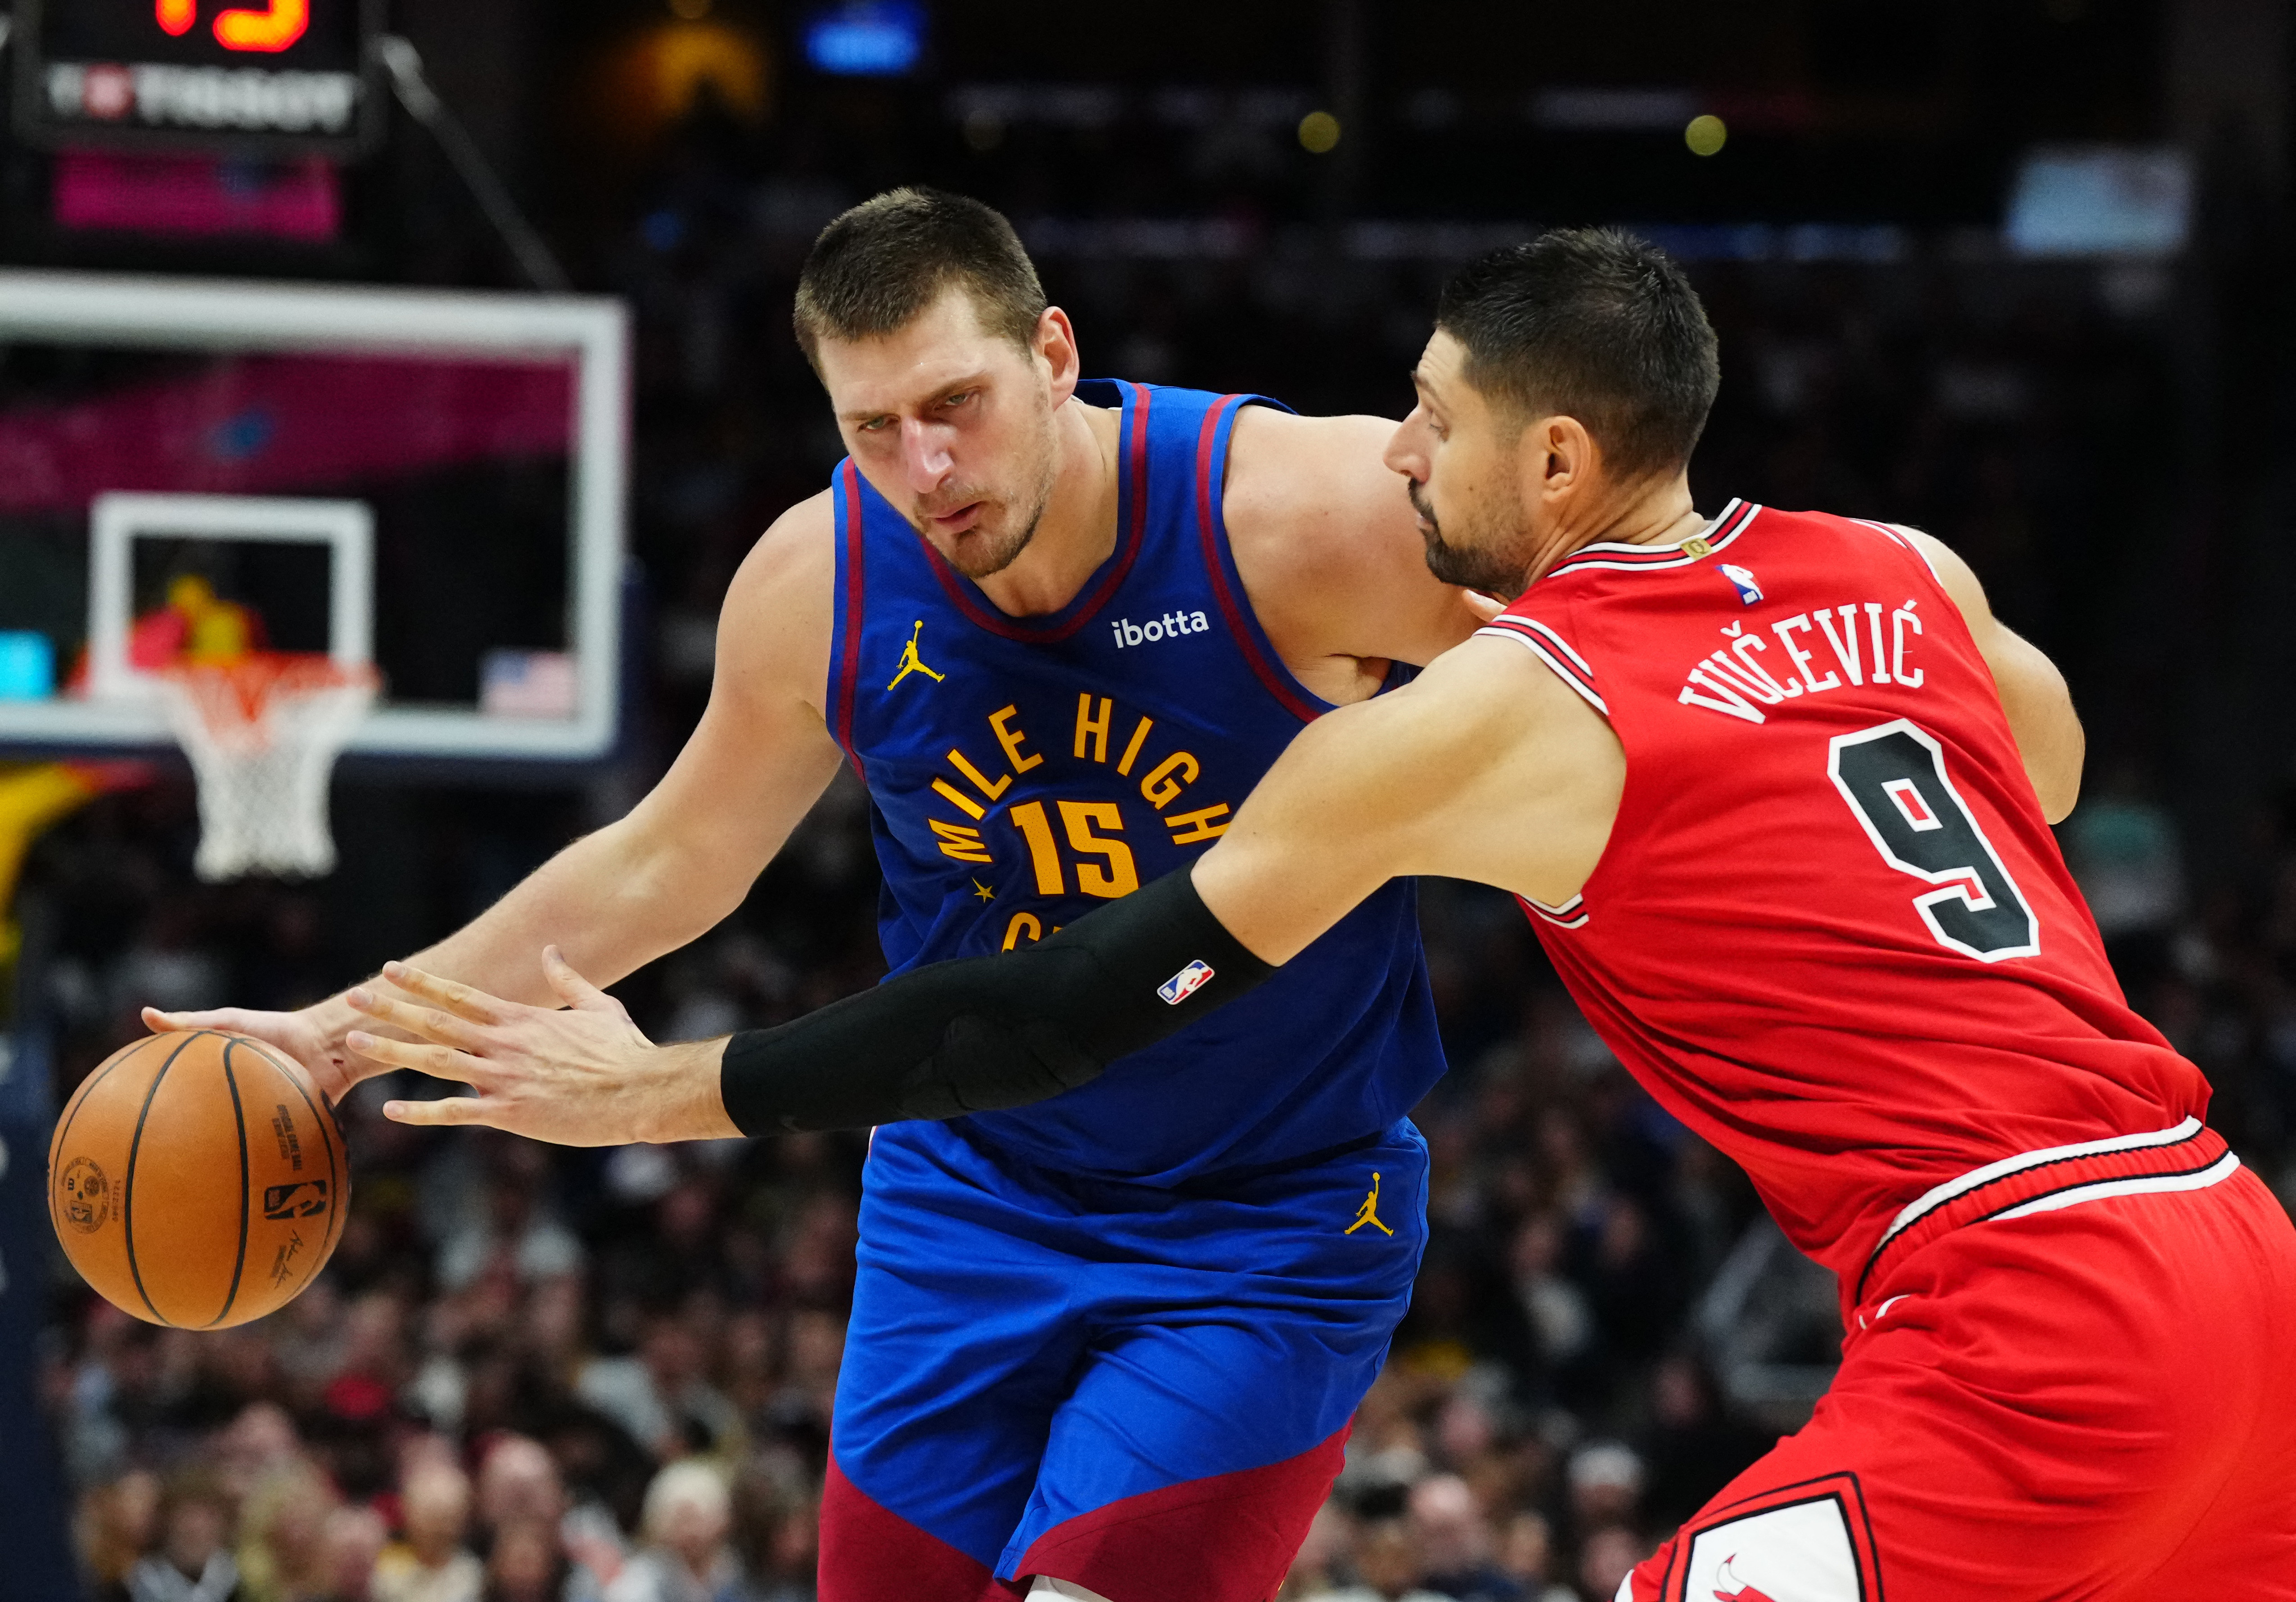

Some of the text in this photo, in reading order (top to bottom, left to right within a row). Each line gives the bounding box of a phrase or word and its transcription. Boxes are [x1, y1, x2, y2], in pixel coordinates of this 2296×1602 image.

[1111, 611, 1210, 649] ibotta
[1677, 598, 1924, 724] VUČEVIĆ
[928, 693, 1232, 863] MILE HIGH
[1827, 717, 2042, 964] 9
[1009, 800, 1140, 899] 15
